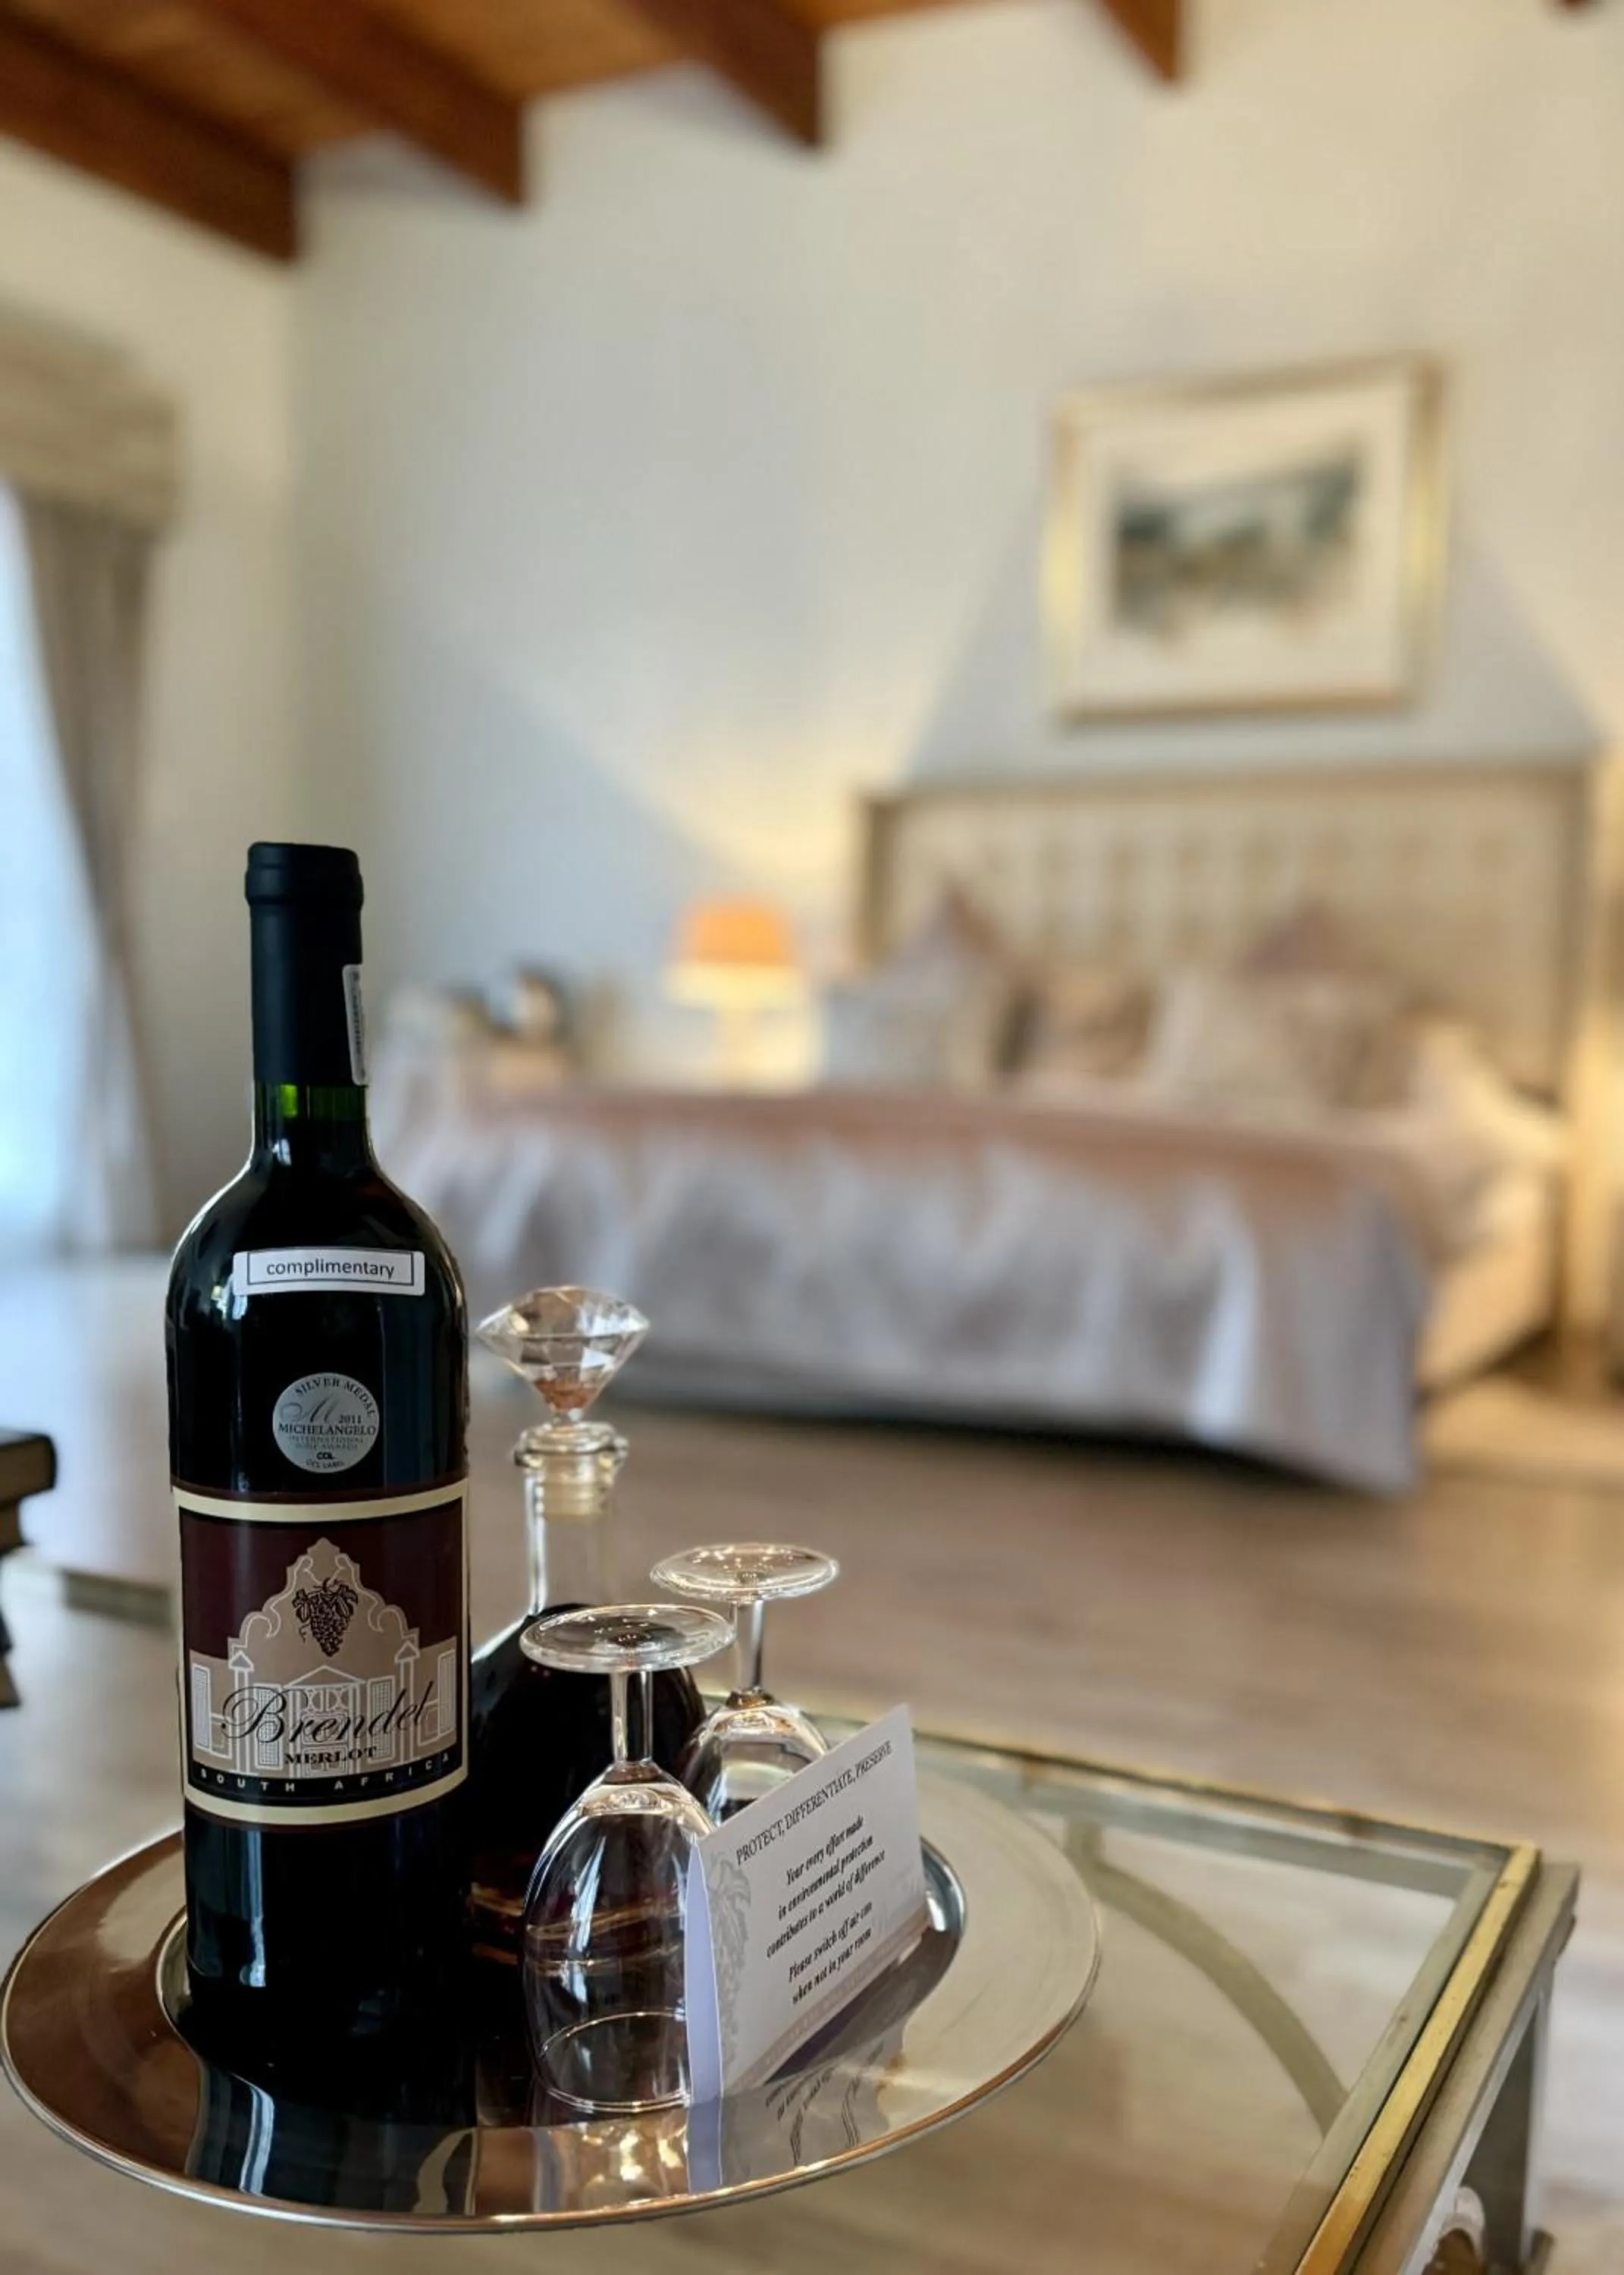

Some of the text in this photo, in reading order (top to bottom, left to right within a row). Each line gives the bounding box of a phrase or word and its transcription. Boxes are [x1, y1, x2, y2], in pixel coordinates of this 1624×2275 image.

[266, 1259, 394, 1280] complimentary
[295, 1377, 376, 1417] SILVER MEDAL
[338, 1414, 362, 1424] 2011
[278, 1422, 377, 1436] MICHELANGELO
[221, 1680, 435, 1744] Brendel
[200, 1754, 450, 1792] SOUTH AFRICA
[284, 1746, 378, 1765] MERLOT
[736, 1740, 892, 1866] PROTECT, DIFFERENTIATE, PRESERVE
[786, 1863, 804, 1885] Your
[806, 1848, 823, 1871] every
[826, 1834, 845, 1856] effort
[788, 1857, 839, 1912] environmental
[841, 1835, 873, 1874] protection
[767, 1916, 808, 1958] contributes
[809, 1907, 817, 1922] to
[825, 1881, 845, 1907] world
[845, 1872, 854, 1893] of
[854, 1850, 885, 1884] difference
[789, 1953, 812, 1982] Please
[814, 1930, 837, 1960] switch
[838, 1916, 849, 1941] off
[792, 1927, 871, 2004] when not in your room
